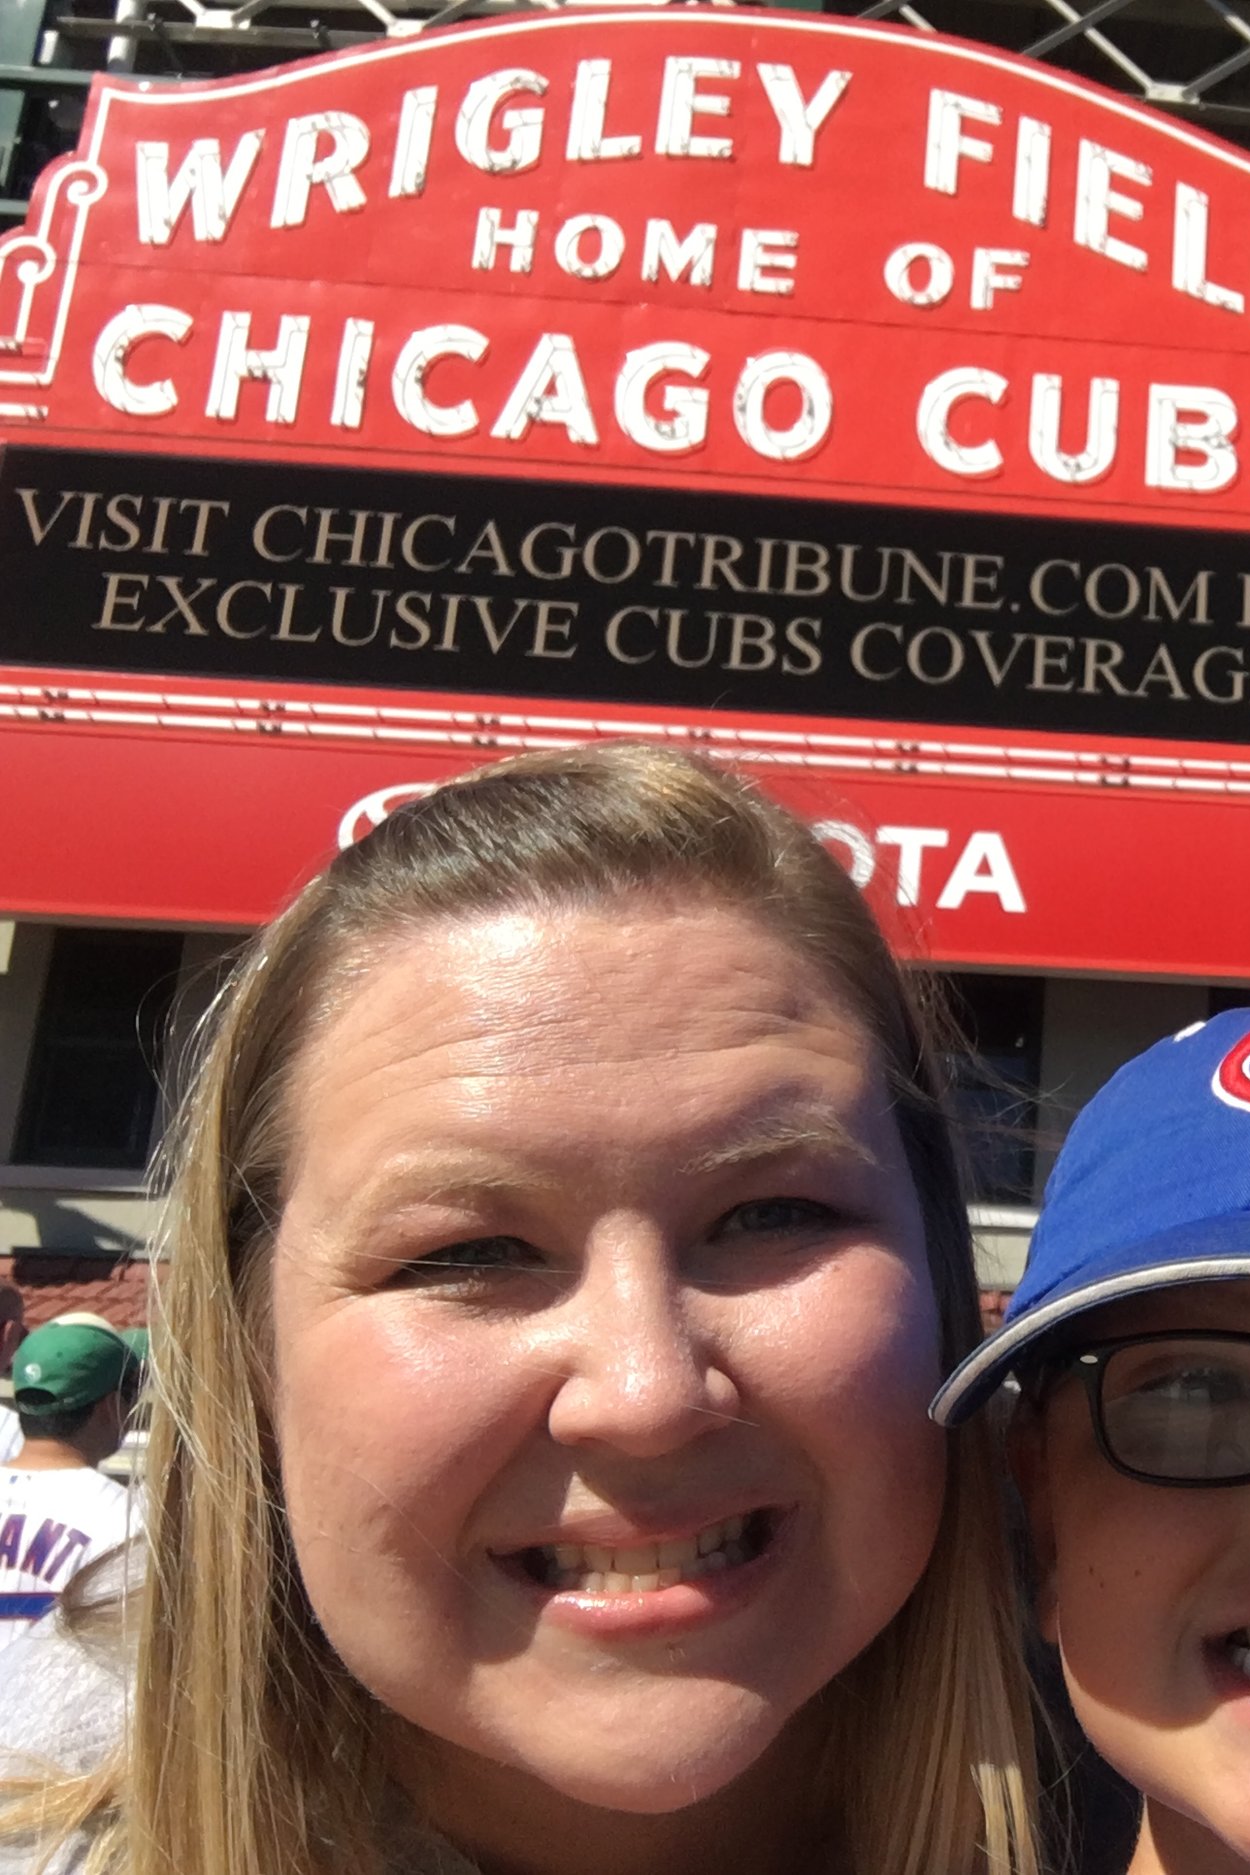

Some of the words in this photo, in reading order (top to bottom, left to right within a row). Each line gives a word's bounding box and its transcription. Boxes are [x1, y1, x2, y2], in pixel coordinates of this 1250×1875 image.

[135, 56, 853, 245] WRIGLEY
[471, 206, 799, 294] HOME
[884, 242, 1030, 310] OF
[92, 303, 833, 461] CHICAGO
[16, 488, 229, 556] VISIT
[251, 504, 1216, 626] CHICAGOTRIBUNE.COM
[91, 571, 579, 660] EXCLUSIVE
[605, 606, 822, 676] CUBS
